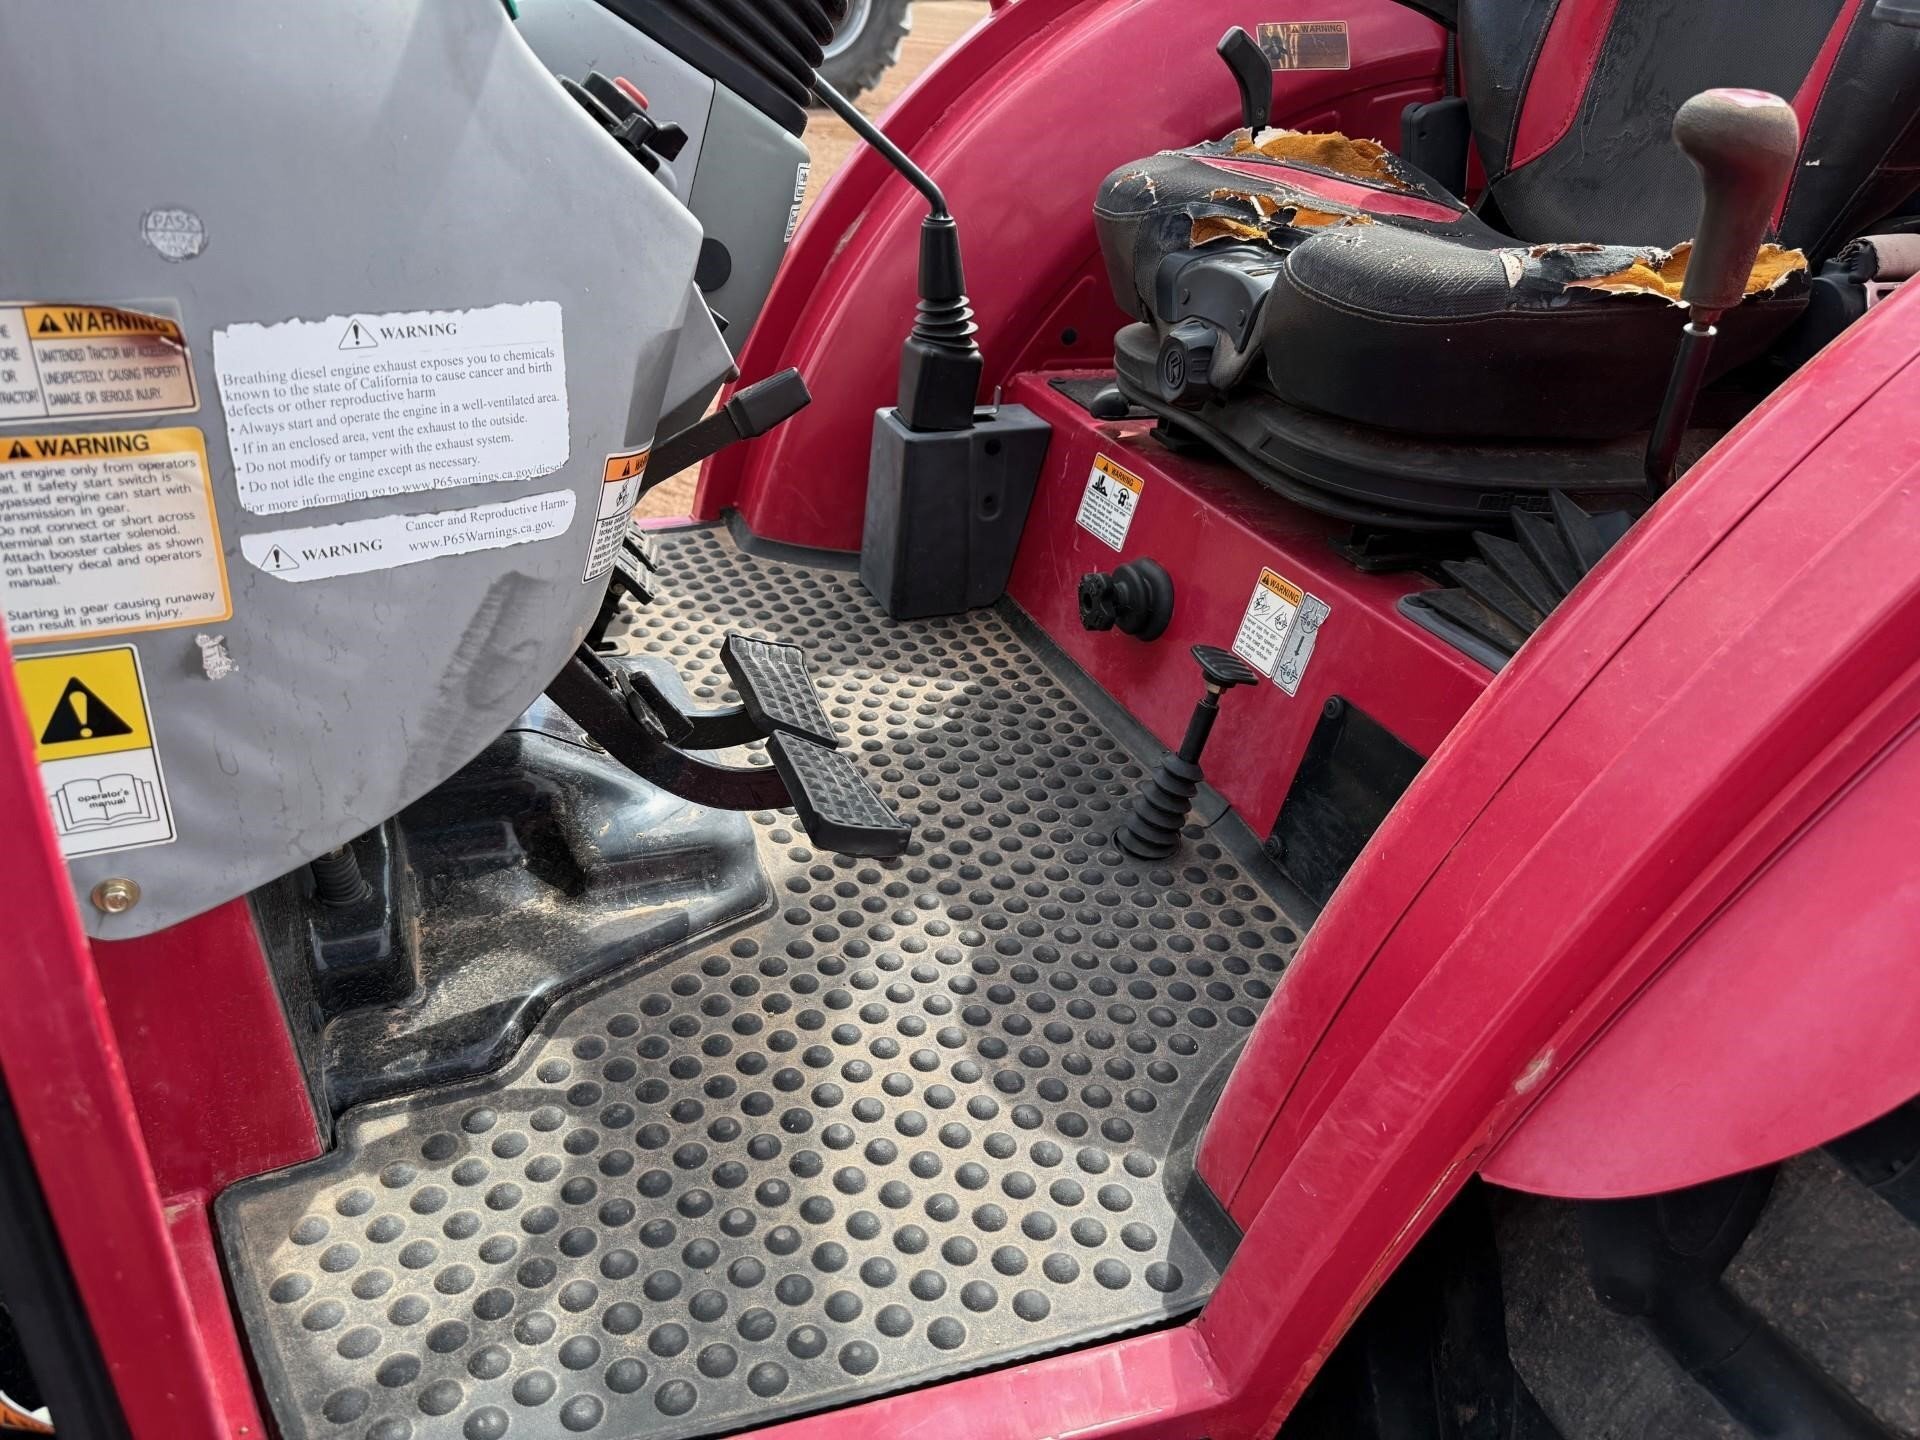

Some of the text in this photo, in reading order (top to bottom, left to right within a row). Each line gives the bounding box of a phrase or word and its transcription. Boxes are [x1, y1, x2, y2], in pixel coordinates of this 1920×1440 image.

[1301, 24, 1343, 33] WARNING
[64, 312, 169, 332] WARNING
[380, 322, 457, 340] WARNING
[107, 367, 141, 381] CAUSING
[143, 365, 180, 378] PROPERTY
[223, 347, 555, 386] Breathing diesel engine exhaust exposes you to chemicals
[225, 361, 552, 402] known to the state of California to cause cancer and birth
[49, 392, 82, 405] DAMAGE
[84, 391, 97, 403] OR
[101, 389, 134, 403] SERIOUS
[228, 388, 436, 417] defects or other reproductive harm
[239, 392, 560, 435] Always start and operate the engine in a well-ventilated area.
[35, 434, 149, 456] WARNING
[242, 412, 528, 454] If in an enclosed area, vent the exhaust to the outside.
[246, 435, 514, 474] Do not modify or tamper with the exhaust system.
[0, 458, 196, 480] art engine only from operators
[249, 456, 480, 493] Do not idle the engine except as necessary.
[1111, 467, 1134, 487] WARNING
[24, 481, 32, 492] If
[38, 480, 77, 491] safety
[83, 478, 112, 489] start
[118, 473, 157, 487] switch
[162, 472, 172, 482] is
[0, 484, 191, 510] ypassed engine can start with
[243, 503, 264, 512] For
[268, 499, 298, 510] more
[302, 490, 368, 505] information
[372, 487, 386, 496] go
[388, 485, 399, 494] to
[0, 505, 130, 522] ansmission in gear.
[0, 511, 196, 536] Do not connect or short across
[405, 519, 444, 531] Cancer
[447, 511, 467, 525] and
[470, 503, 537, 522] Reproductive
[0, 525, 181, 549] terminal on starter solenoid.
[3, 537, 204, 563] Attach booster cables as shown
[302, 539, 383, 561] WARNING
[6, 550, 202, 576] on battery decal and operators
[9, 575, 61, 588] manual.
[1269, 579, 1299, 603] WARNING
[8, 592, 215, 620] Starting in gear causing runaway
[11, 608, 182, 633] can result in serious injury.
[77, 788, 129, 802] operator's
[89, 797, 126, 808] manual
